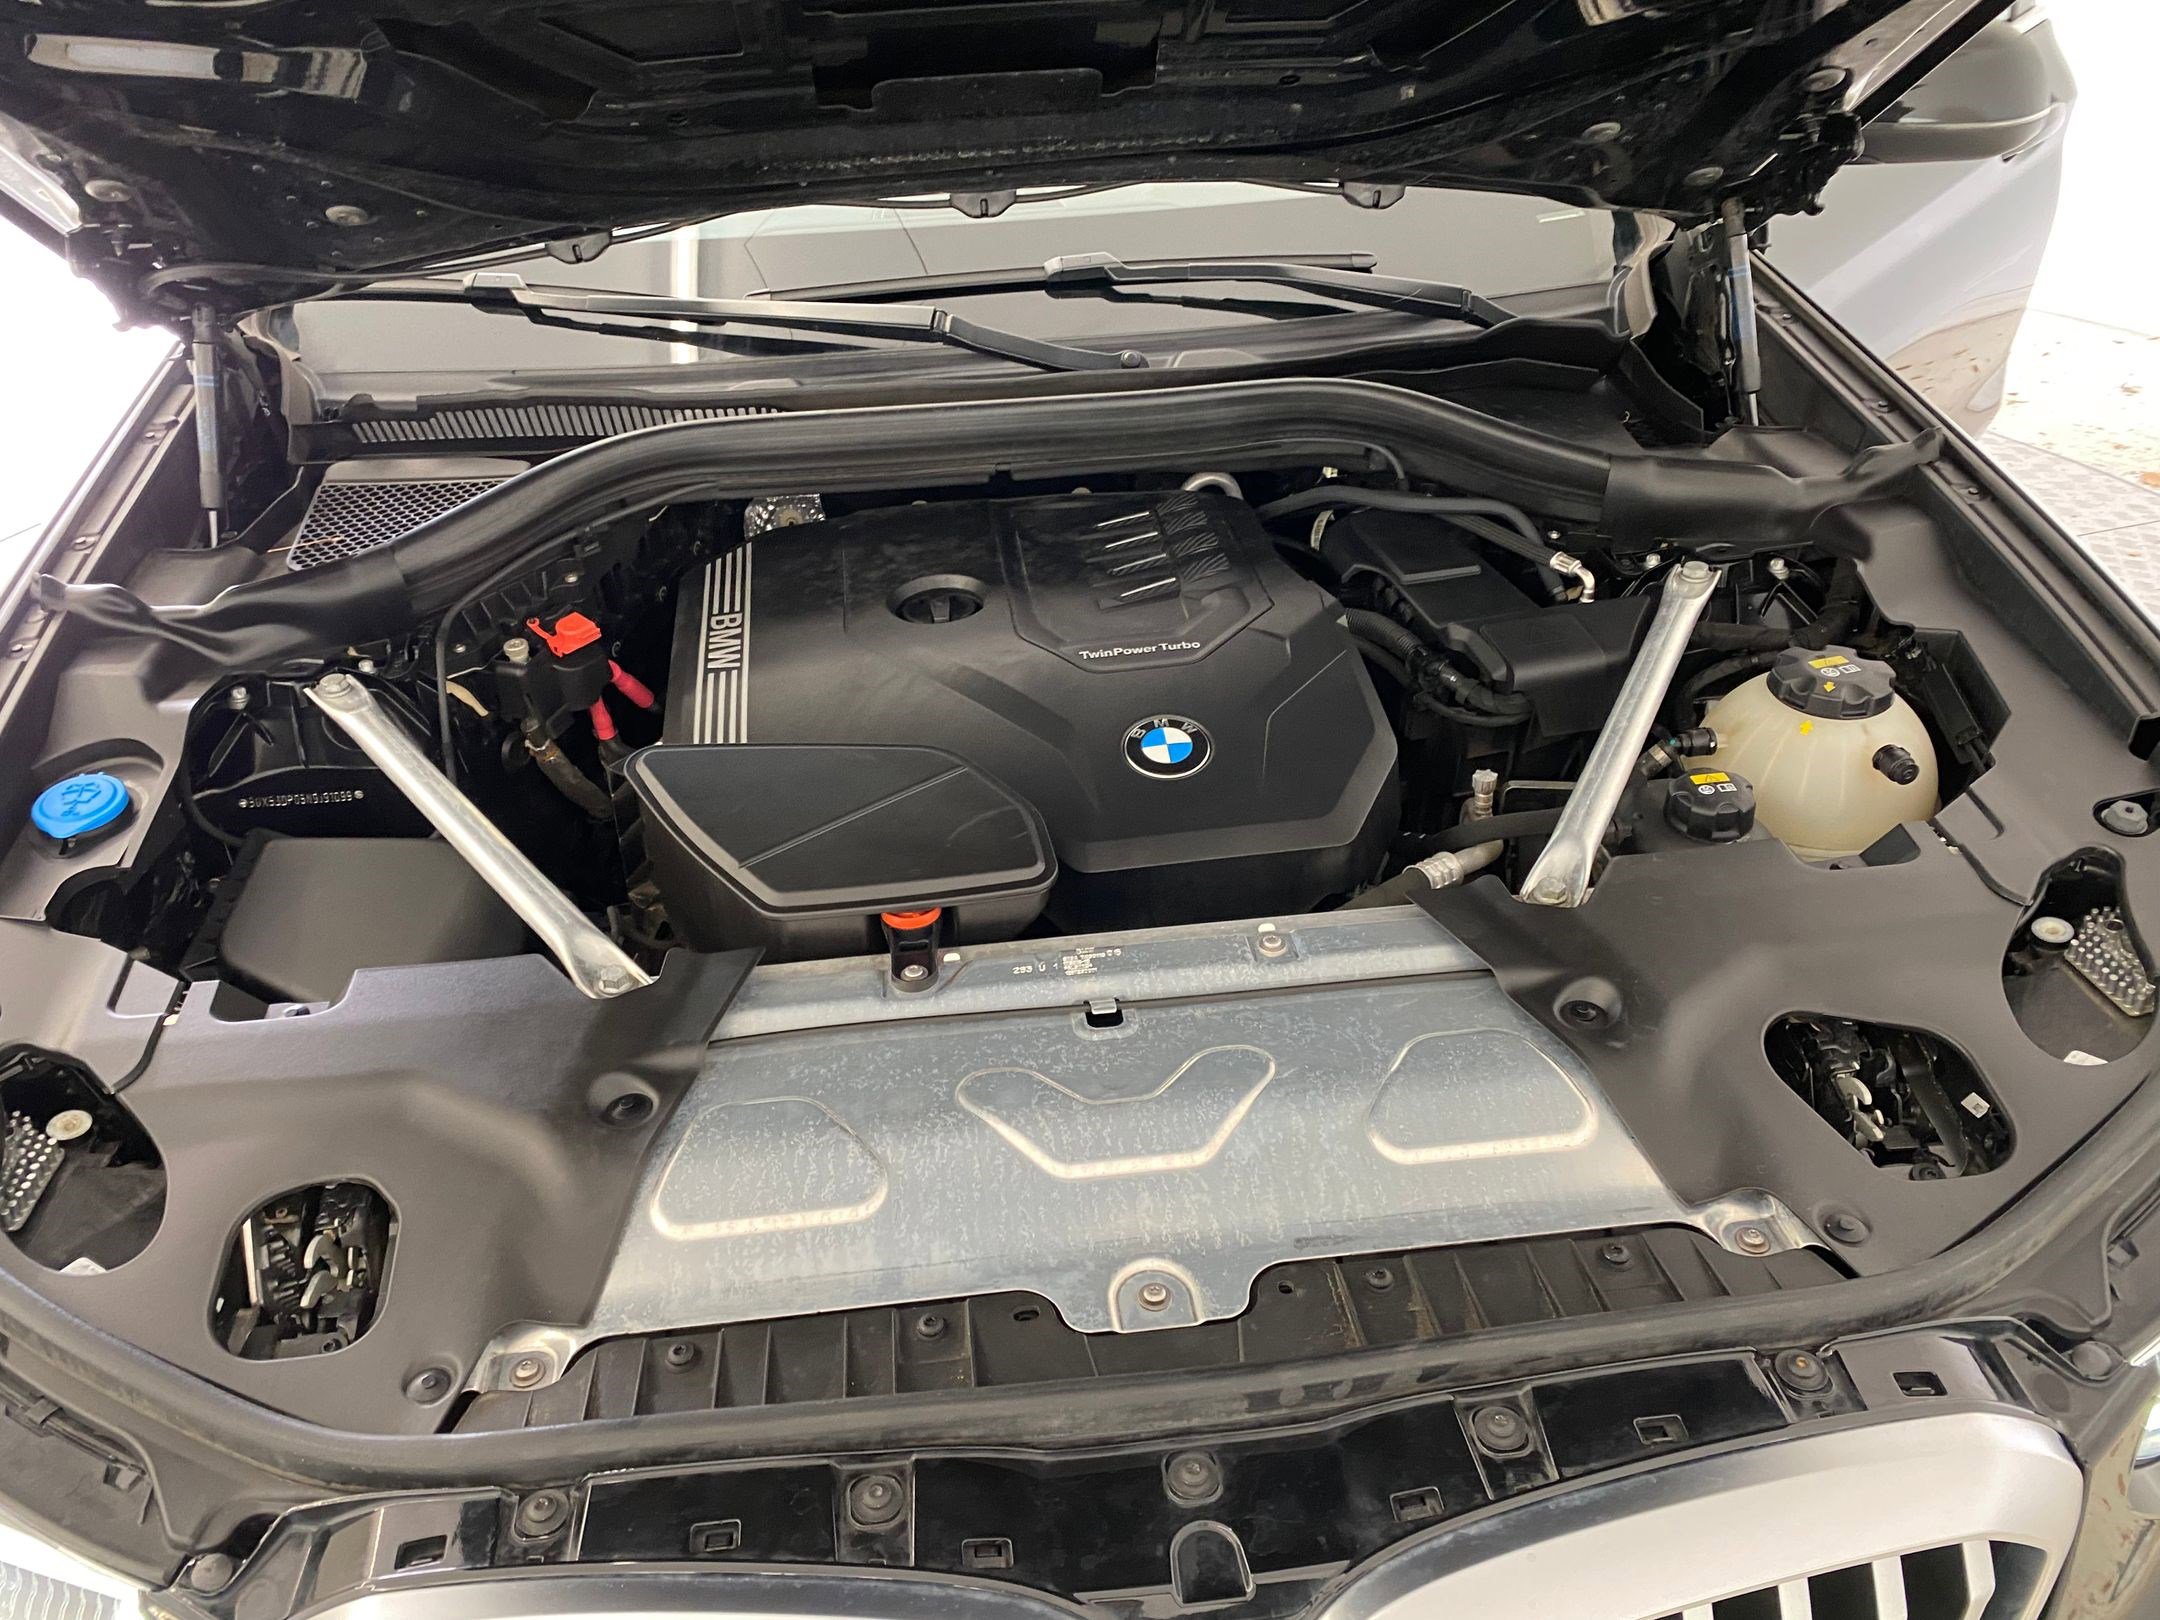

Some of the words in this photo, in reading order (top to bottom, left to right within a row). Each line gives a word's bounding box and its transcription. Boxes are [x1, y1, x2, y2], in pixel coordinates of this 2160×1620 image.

[707, 612, 743, 669] BMW
[1078, 645, 1157, 659] TwinPower
[1158, 641, 1201, 651] Turbo
[1130, 717, 1198, 739] BMW
